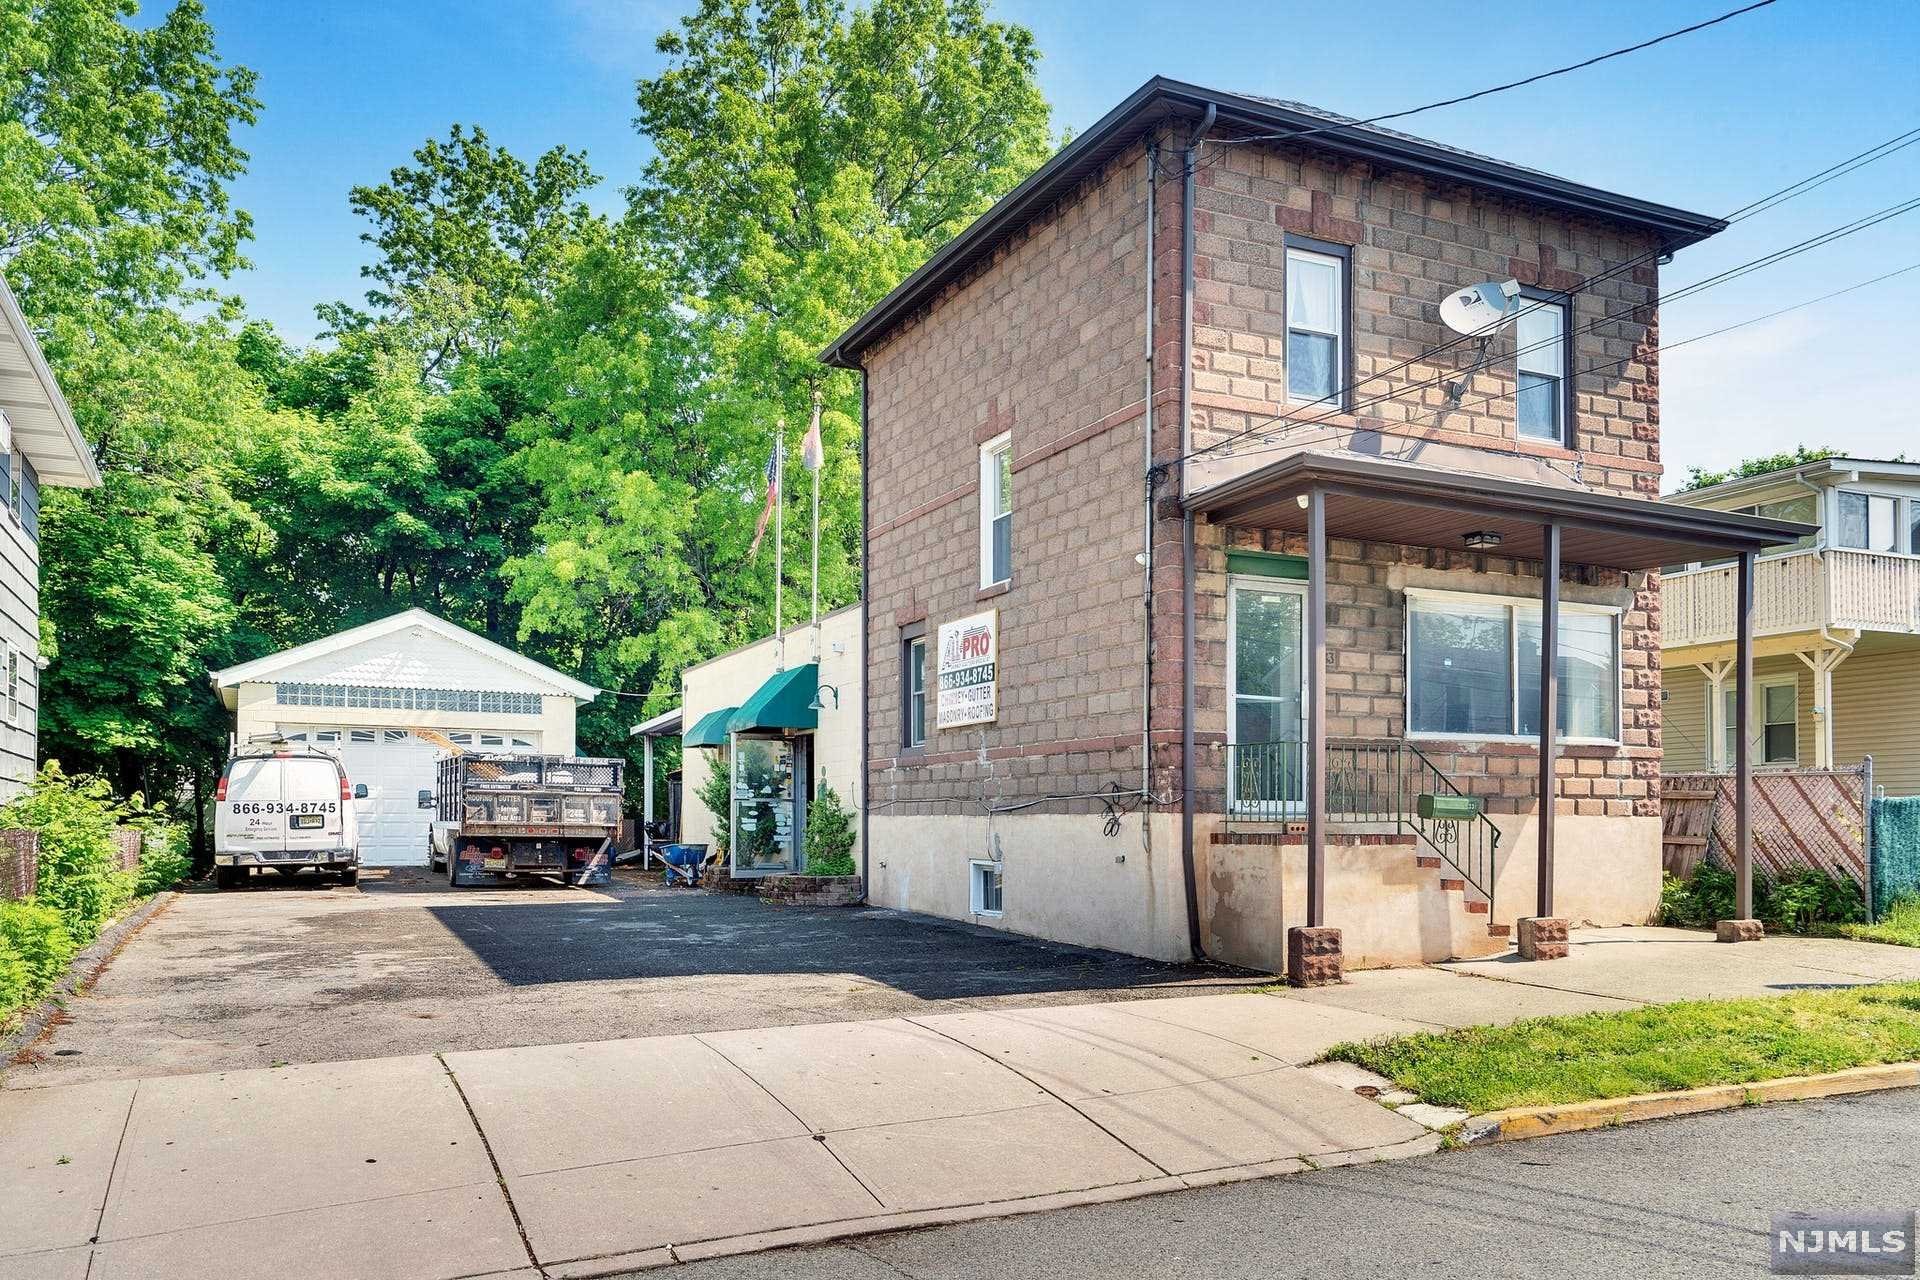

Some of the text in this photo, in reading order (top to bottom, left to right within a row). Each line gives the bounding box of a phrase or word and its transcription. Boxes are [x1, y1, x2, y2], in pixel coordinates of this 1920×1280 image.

[939, 665, 993, 690] 866-934-8745
[232, 802, 336, 815] 866-934-8745
[249, 818, 260, 826] 24
